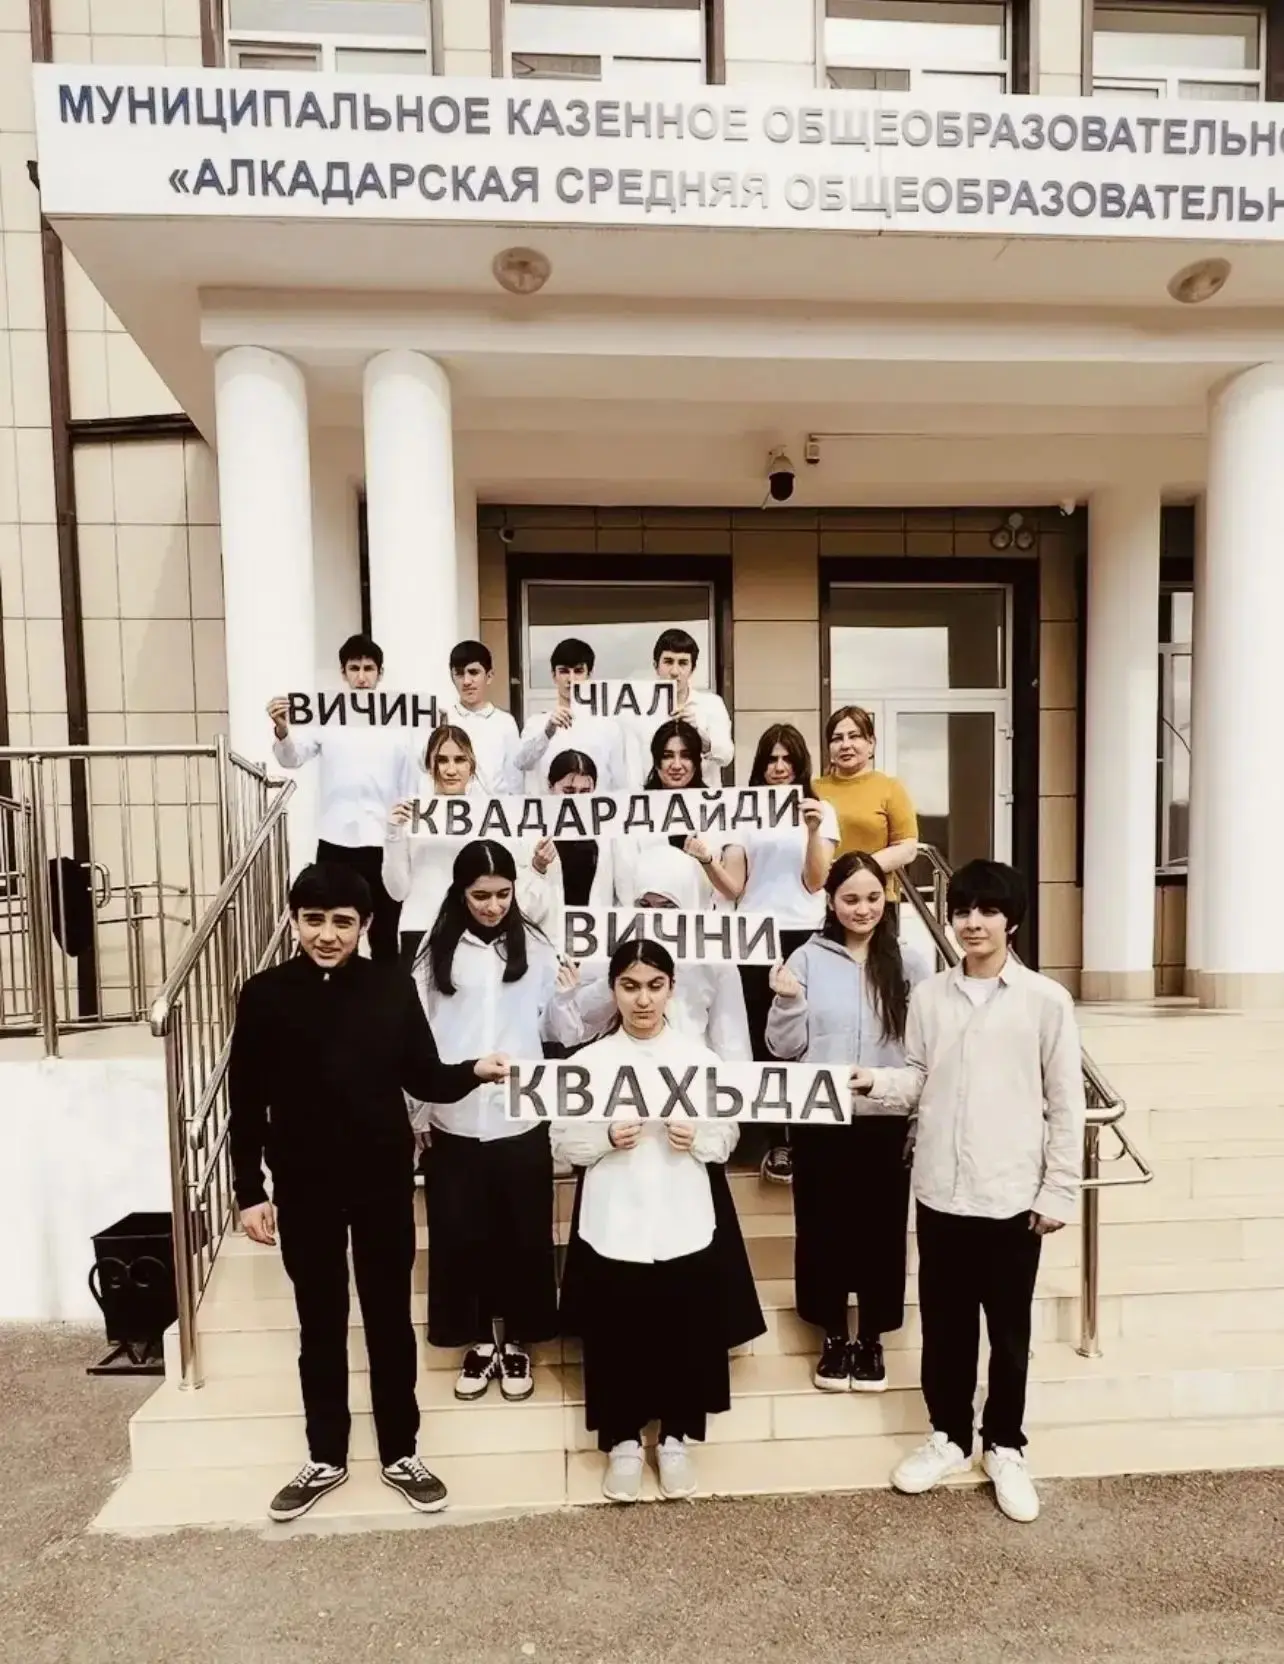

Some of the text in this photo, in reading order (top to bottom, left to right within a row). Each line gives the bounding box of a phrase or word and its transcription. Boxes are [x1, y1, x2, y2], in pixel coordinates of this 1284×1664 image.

[59, 85, 1284, 157] МУНИЦИПАЛЬНОЕ КАЗЕННОЕ ОБЩЕОБРАЗОВАТЕЛЬН
[168, 158, 539, 205] «АЛКАДАРСКАЯ
[557, 167, 768, 213] СРЕДНЯЯ
[288, 692, 437, 728] ВИЧИН
[564, 911, 776, 960] ВИЧНИ
[509, 1064, 845, 1122] КВАХЬДА
